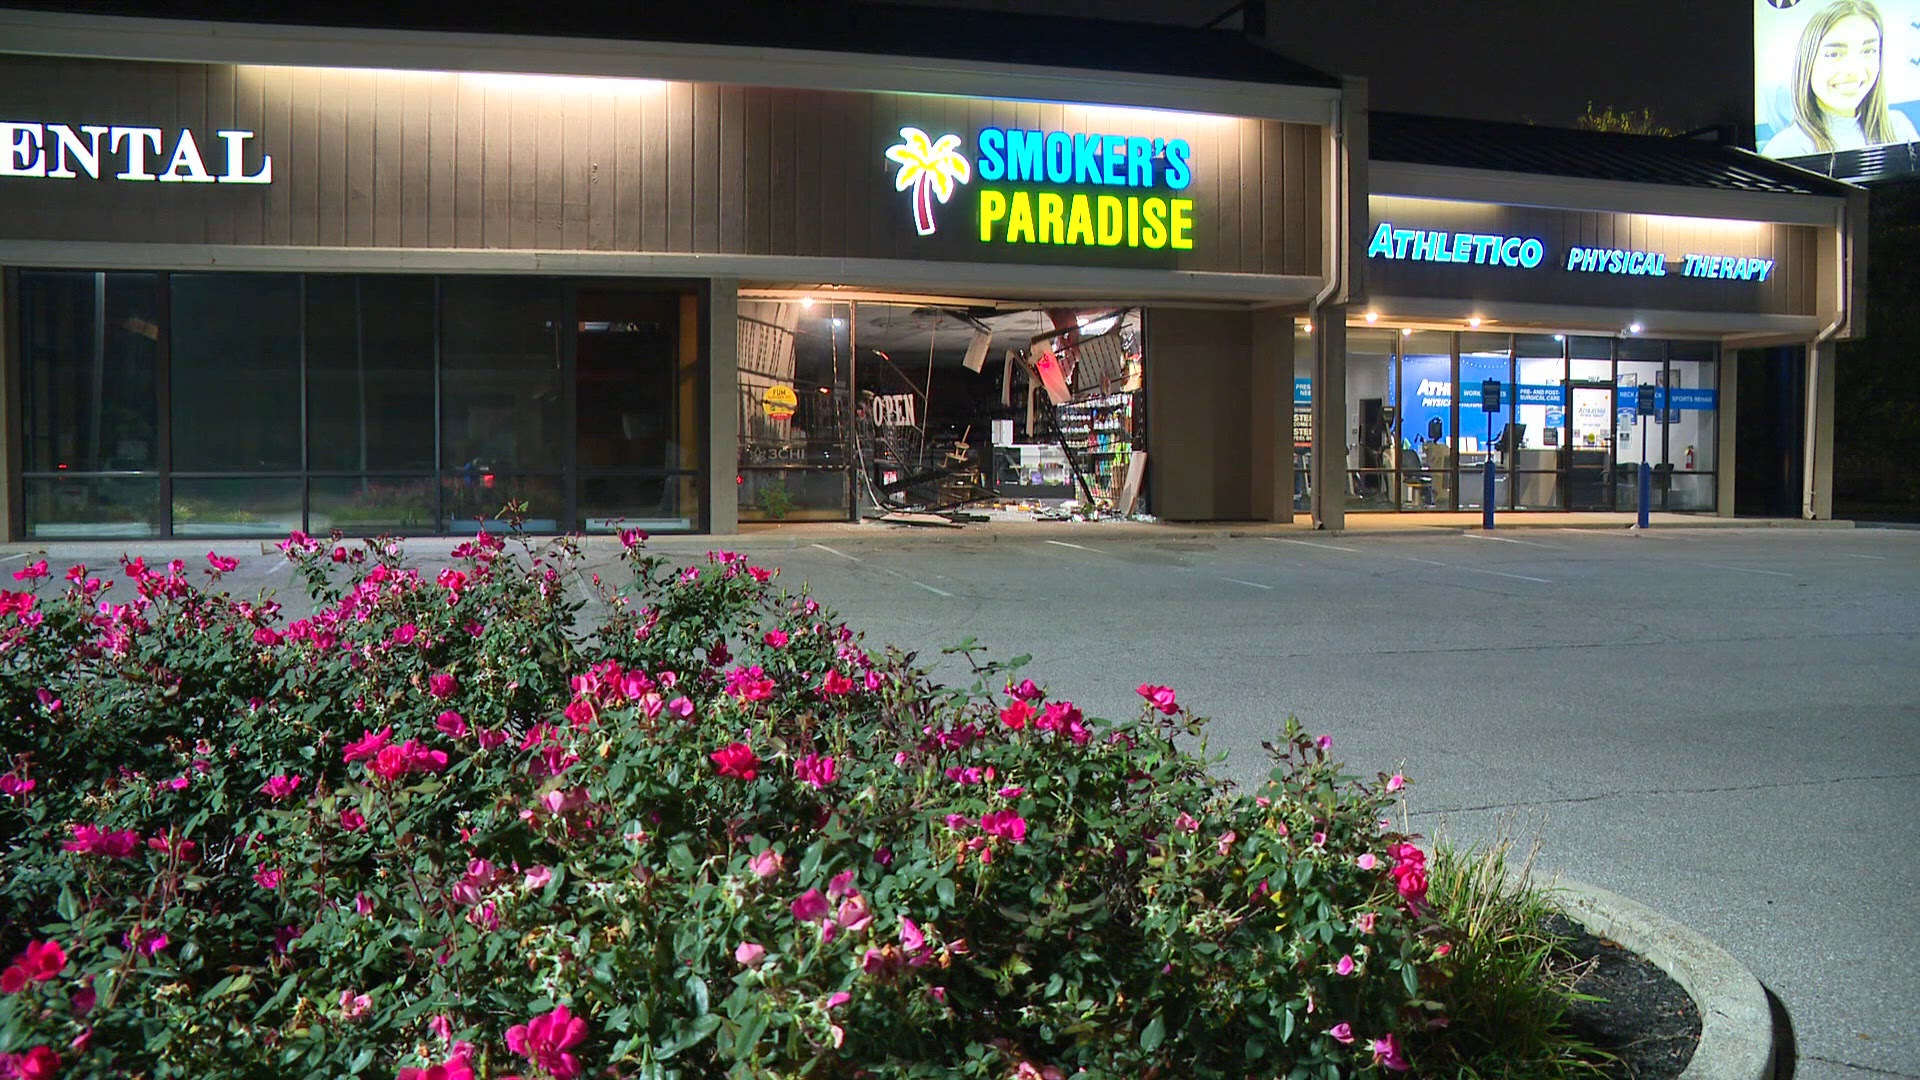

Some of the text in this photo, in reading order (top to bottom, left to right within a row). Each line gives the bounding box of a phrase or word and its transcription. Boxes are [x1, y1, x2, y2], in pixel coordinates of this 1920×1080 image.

[0, 121, 273, 184] ENTAL
[978, 127, 1192, 190] SMOKER'S
[979, 190, 1194, 251] PARADISE
[1368, 222, 1544, 269] ATHLETICO
[1567, 246, 1774, 283] PHYSICAL THERAPY
[873, 393, 915, 428] OPEN
